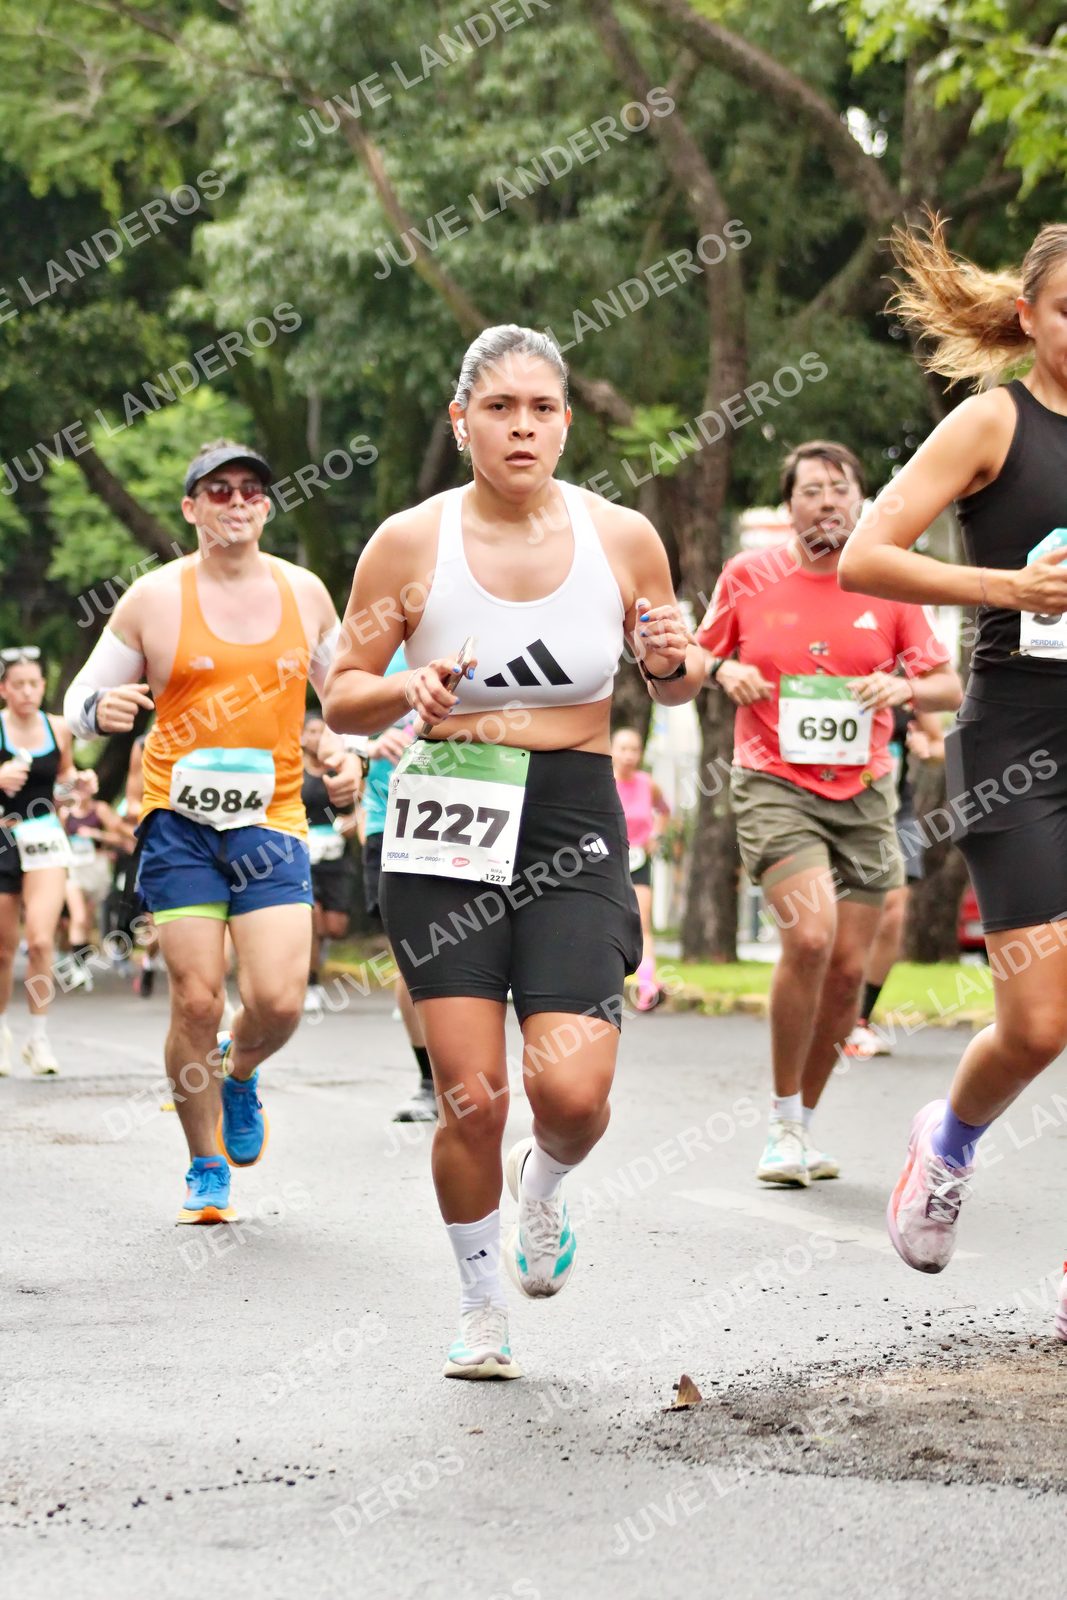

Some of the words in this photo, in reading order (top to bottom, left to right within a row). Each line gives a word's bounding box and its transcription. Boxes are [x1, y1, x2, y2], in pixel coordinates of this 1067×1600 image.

[1031, 639, 1064, 648] PERDURA
[799, 717, 857, 741] 690
[177, 785, 263, 813] 4984
[395, 798, 510, 849] 1227
[387, 851, 409, 859] PERDURA
[485, 873, 506, 883] 1227
